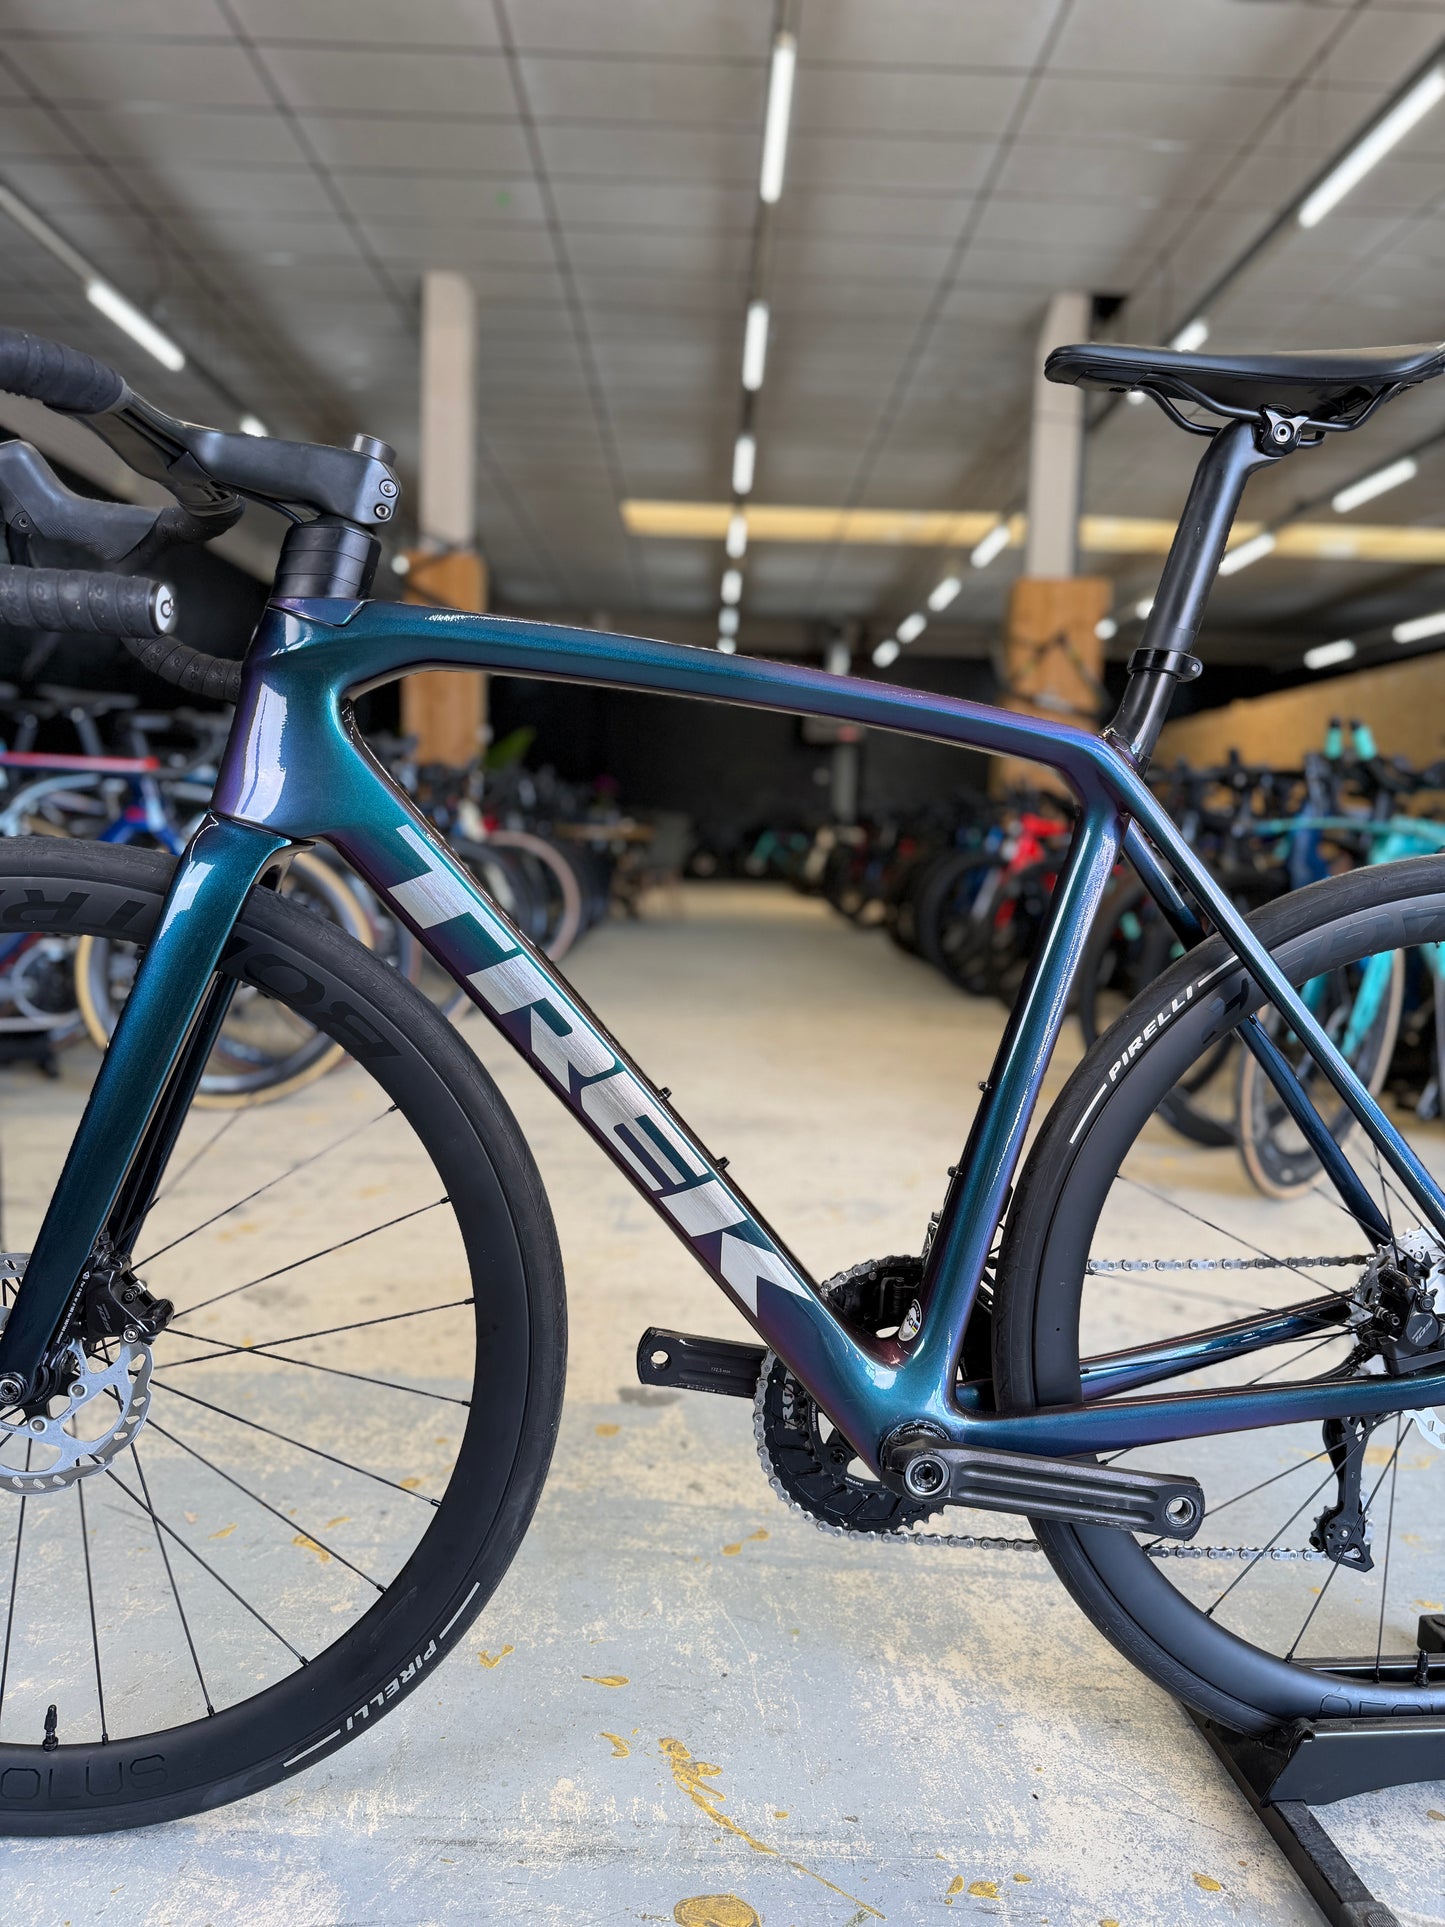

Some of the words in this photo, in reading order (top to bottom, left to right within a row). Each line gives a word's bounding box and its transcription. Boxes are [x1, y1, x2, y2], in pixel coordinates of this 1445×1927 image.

[387, 823, 813, 1317] TREK
[1108, 985, 1193, 1082] PIRELLI
[346, 1639, 437, 1731] PIRELLI
